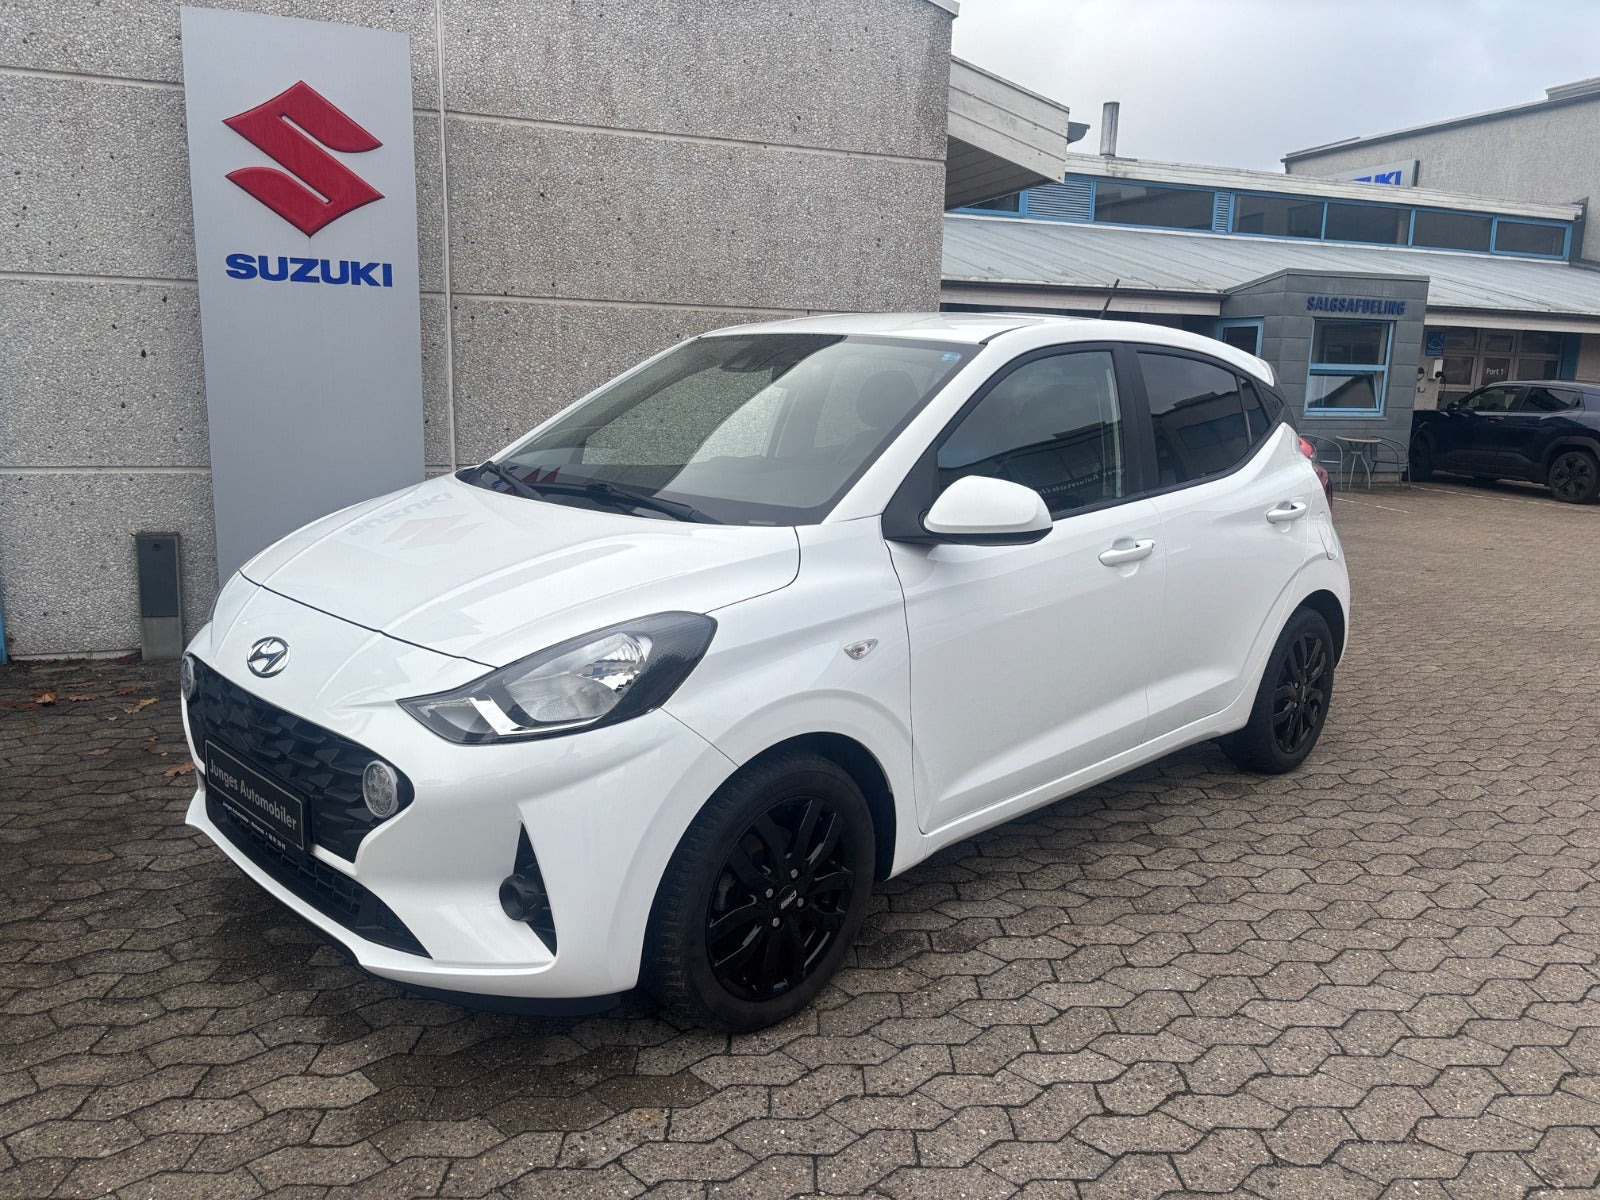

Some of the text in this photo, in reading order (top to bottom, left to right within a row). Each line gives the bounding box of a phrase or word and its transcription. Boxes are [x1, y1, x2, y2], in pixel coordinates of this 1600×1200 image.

[225, 253, 393, 288] SUZUKI
[1307, 296, 1405, 315] SALGSAFDELING
[209, 759, 238, 790] Junges
[240, 779, 297, 830] Automobiler
